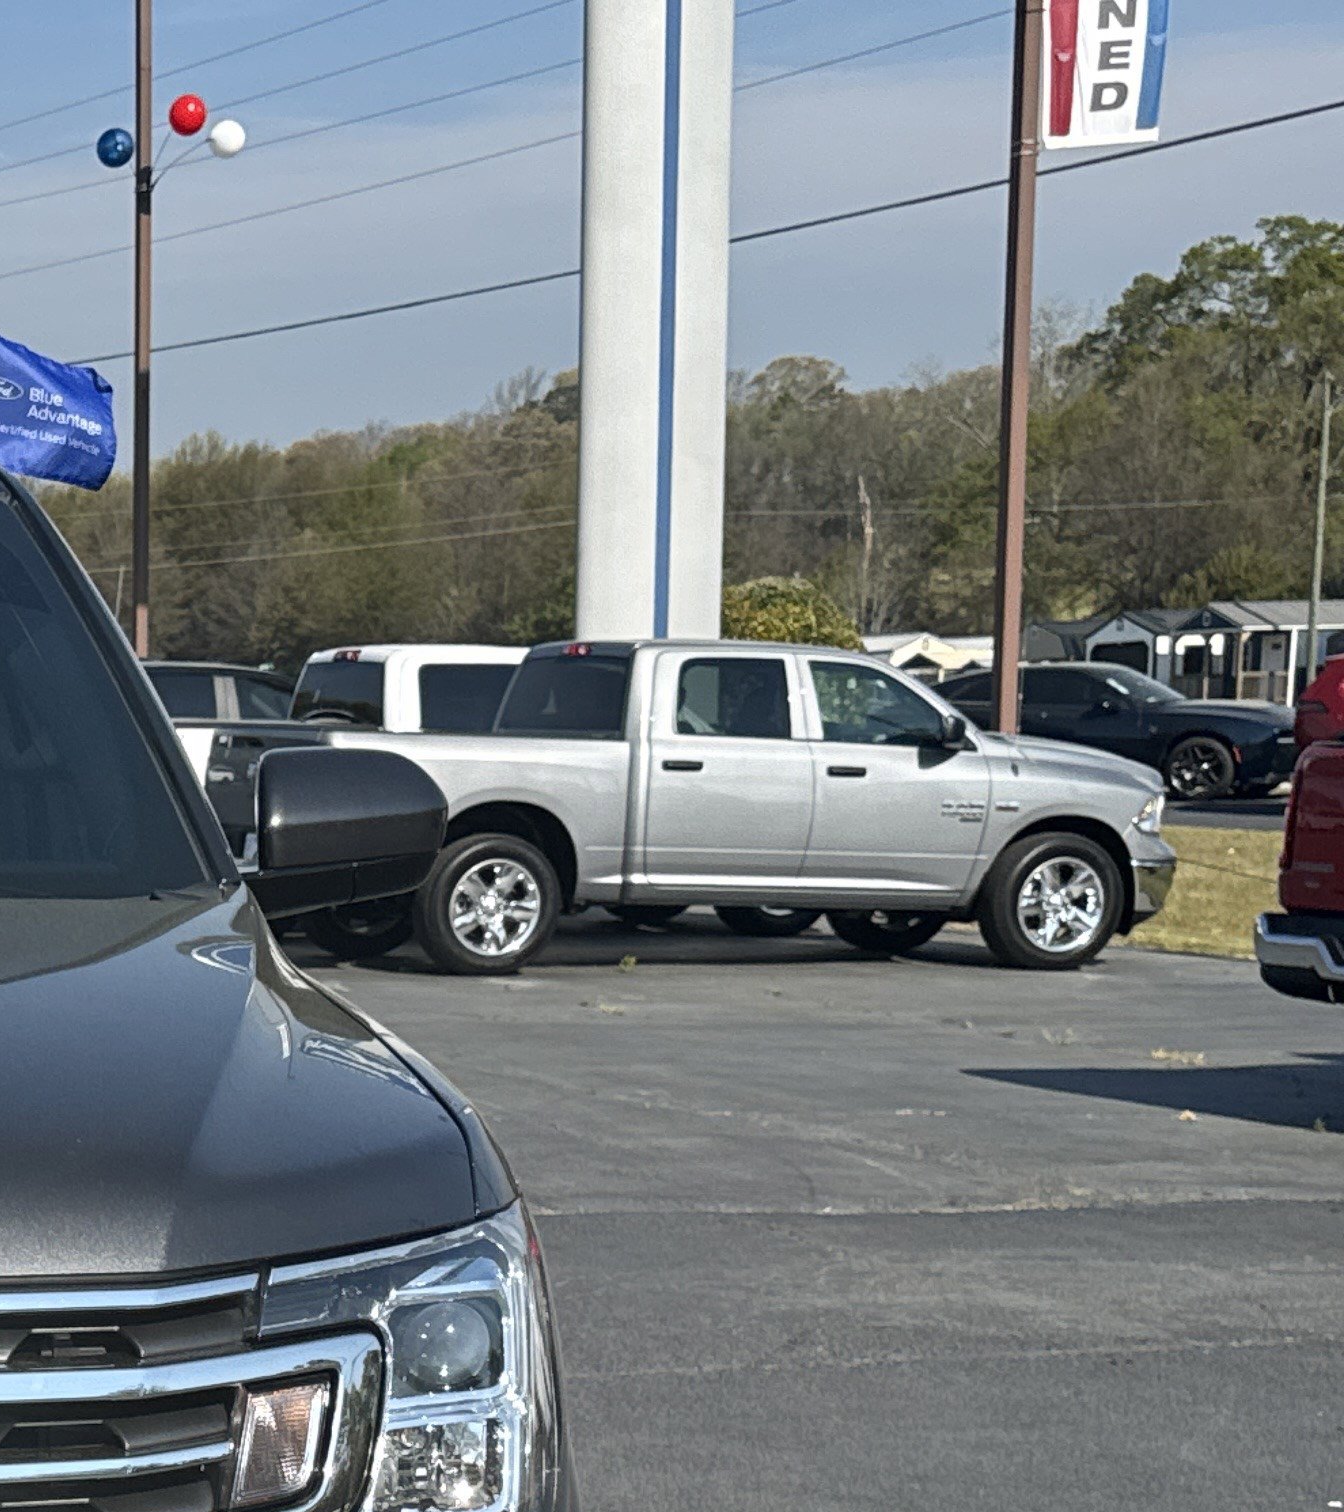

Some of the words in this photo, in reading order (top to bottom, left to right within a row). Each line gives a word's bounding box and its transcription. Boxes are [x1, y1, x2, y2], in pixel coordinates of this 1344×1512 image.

[29, 387, 64, 406] Blue
[26, 404, 102, 436] Advantage
[39, 429, 67, 445] Used
